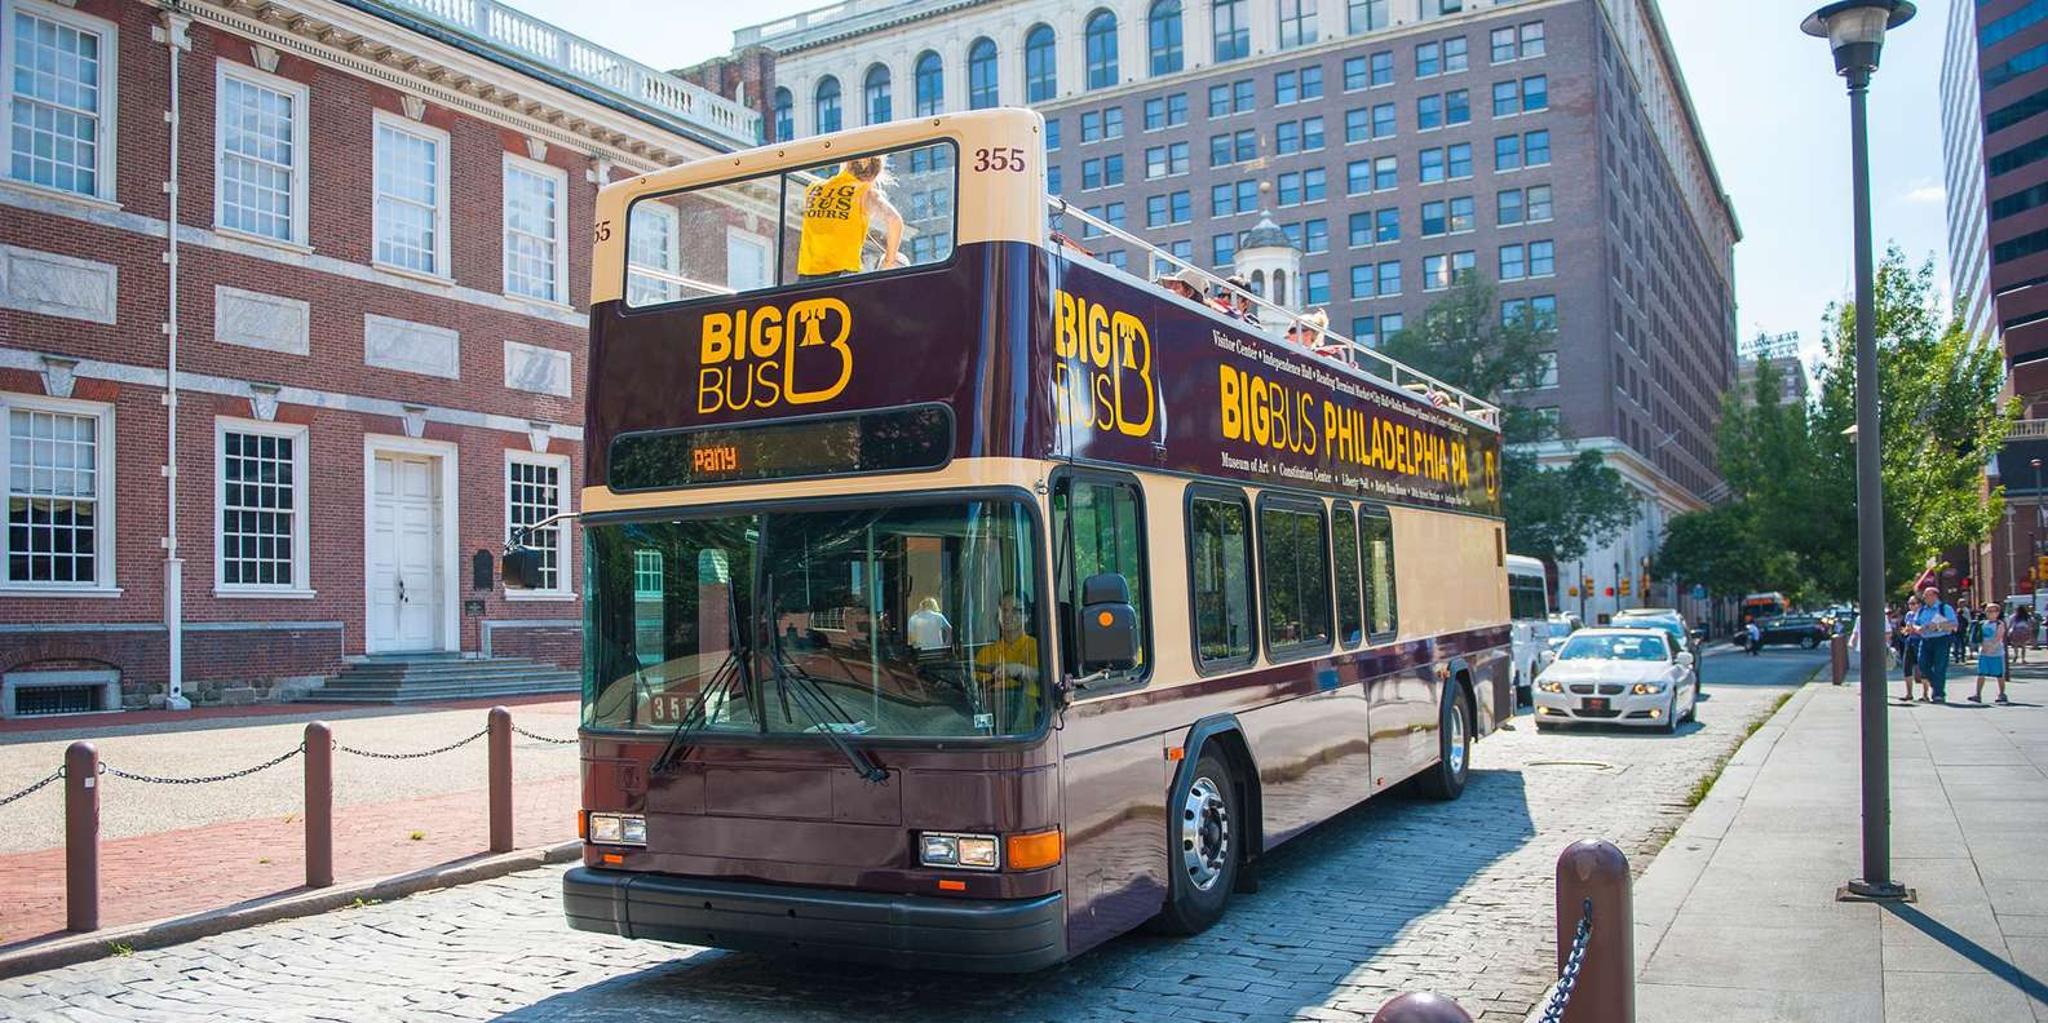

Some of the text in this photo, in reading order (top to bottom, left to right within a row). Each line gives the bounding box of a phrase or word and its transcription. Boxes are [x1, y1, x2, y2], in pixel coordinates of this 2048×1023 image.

[974, 147, 1026, 172] 355
[804, 209, 849, 220] OURS
[701, 305, 783, 365] BIG
[1055, 288, 1111, 368] BIG
[1212, 329, 1236, 352] Visitor
[1236, 338, 1258, 361] Center
[1262, 348, 1301, 376] Independence
[698, 361, 780, 414] BUS
[1221, 451, 1249, 471] Museum
[1250, 457, 1258, 472] of
[1258, 458, 1270, 474] Art
[1279, 462, 1314, 480] Constitution
[1313, 467, 1332, 483] Center
[1323, 400, 1449, 484] PHILADELPHIA
[1450, 440, 1470, 487] PA
